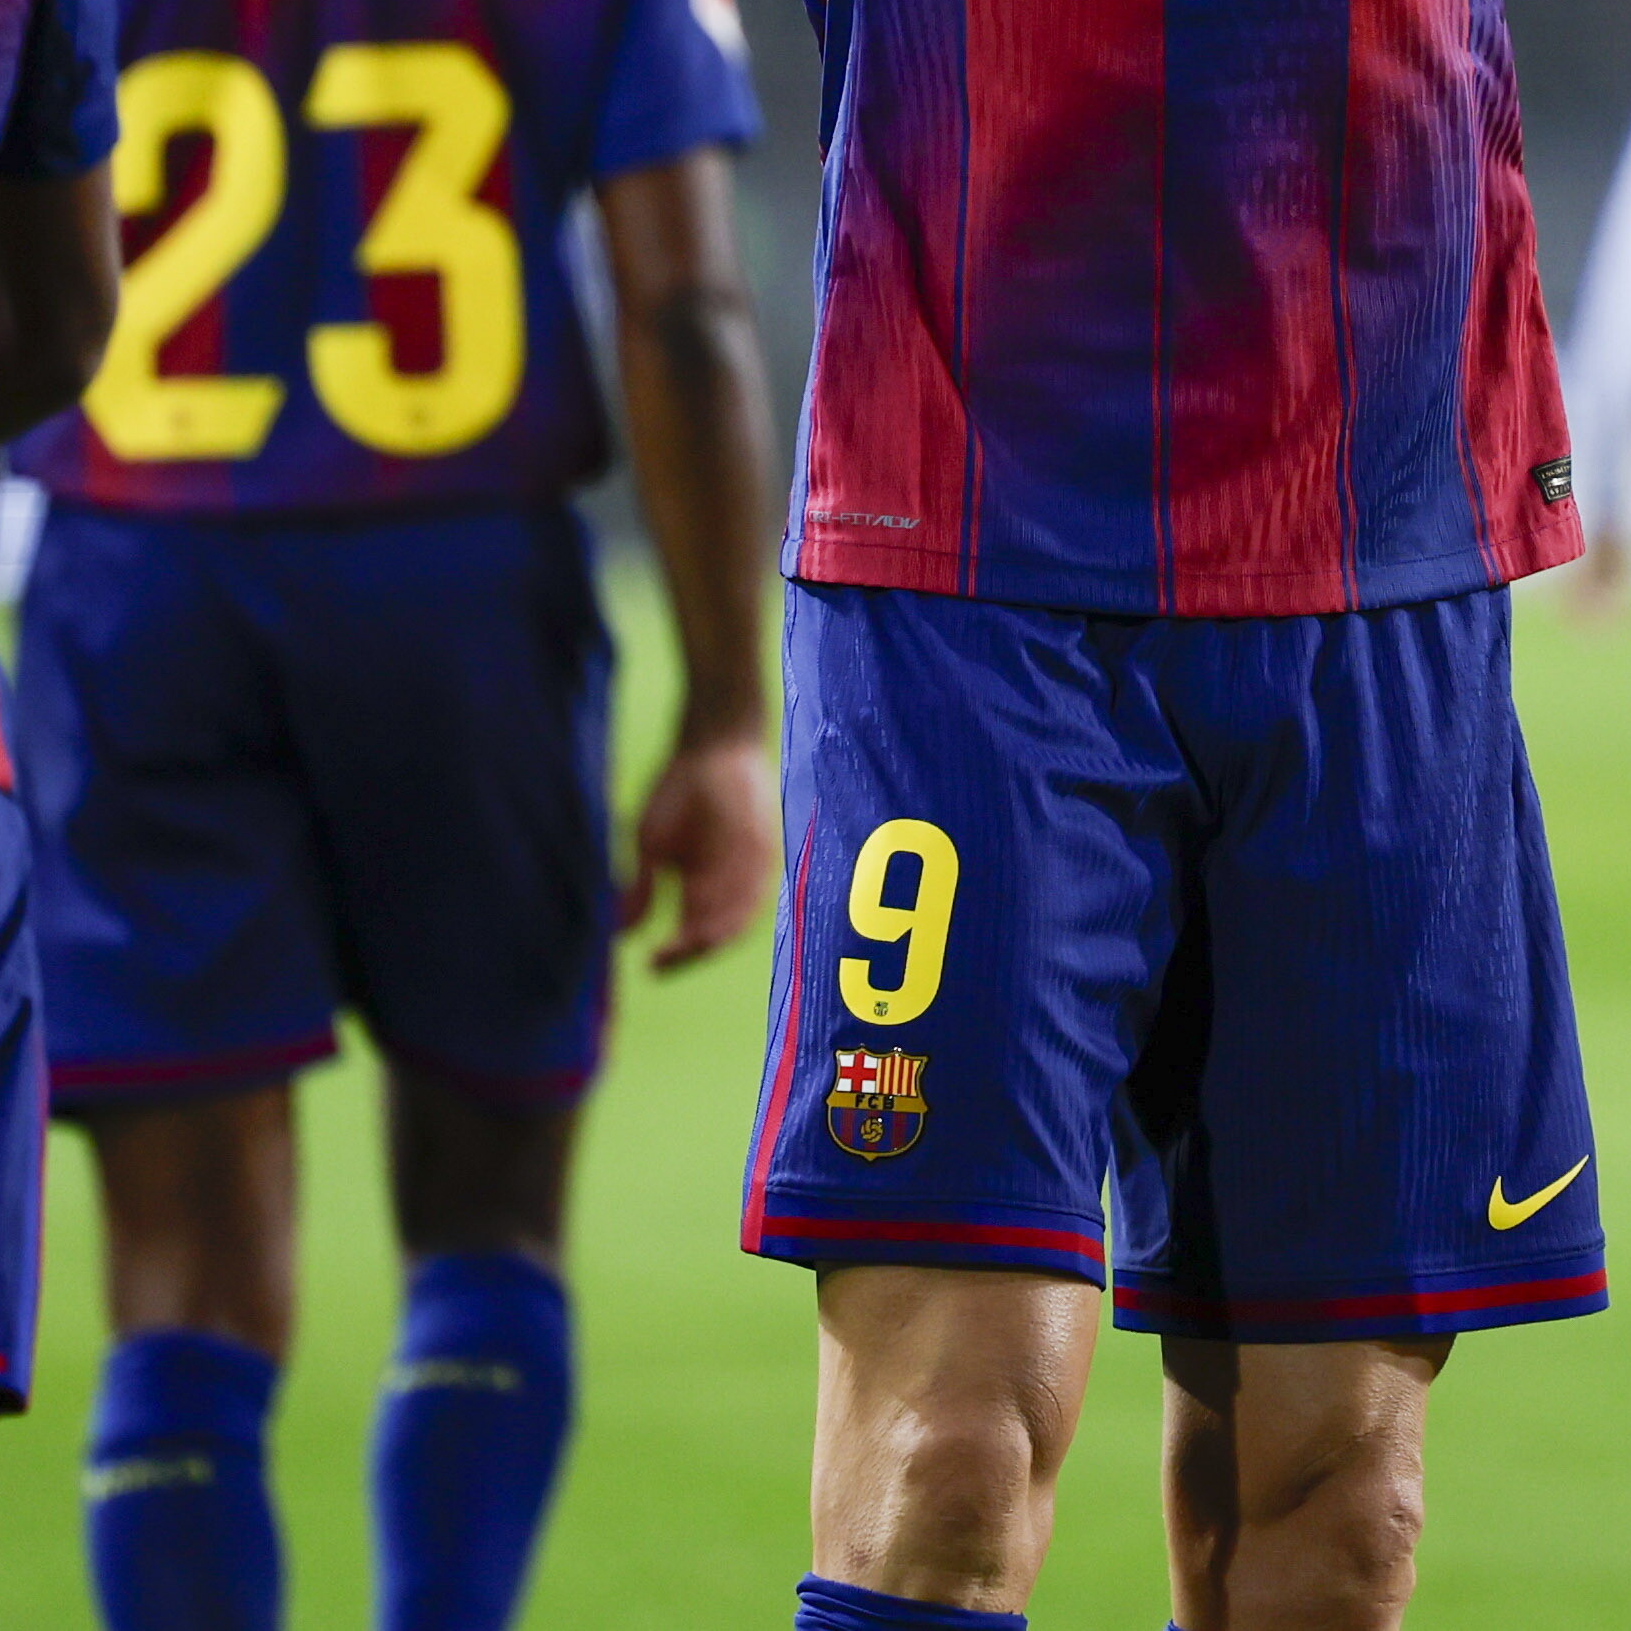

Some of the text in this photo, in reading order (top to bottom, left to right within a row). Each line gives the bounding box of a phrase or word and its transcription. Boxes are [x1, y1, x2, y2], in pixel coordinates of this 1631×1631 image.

[80, 42, 525, 460] 23
[838, 818, 960, 1026] 9
[854, 1093, 896, 1110] FCB
